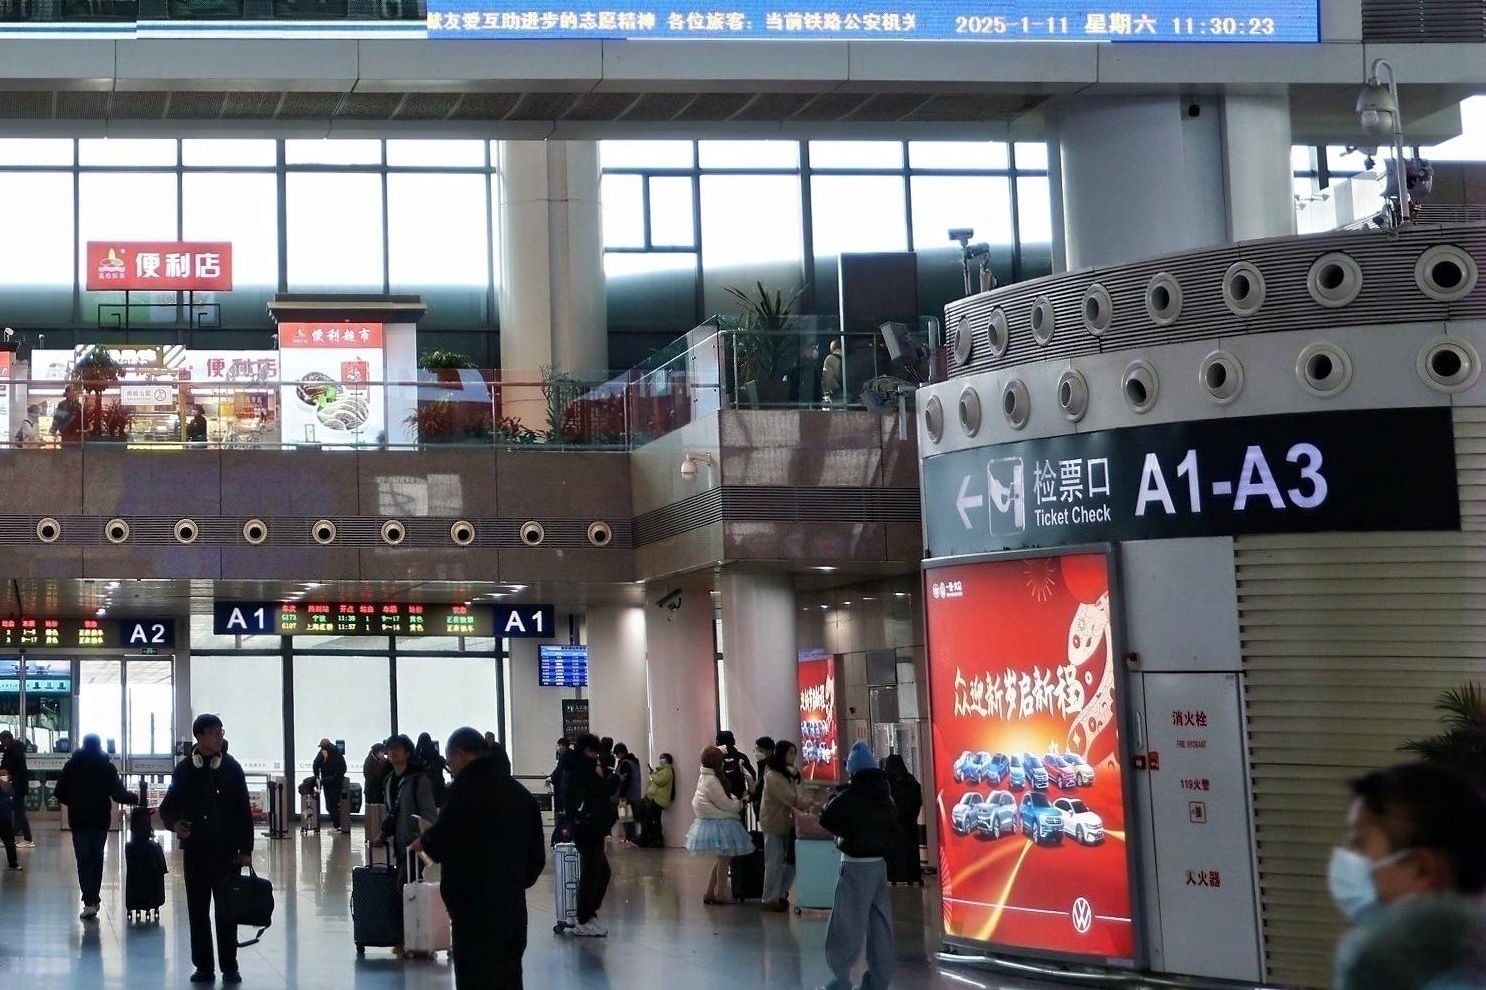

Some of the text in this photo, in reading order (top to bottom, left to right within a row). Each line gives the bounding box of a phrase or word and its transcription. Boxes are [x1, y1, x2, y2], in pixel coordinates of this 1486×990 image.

[955, 13, 1275, 36] 2025-1-11 星期六 11:30:23
[135, 251, 220, 278] 便利店
[310, 327, 371, 343] 便利超市
[206, 357, 277, 378] 便利店
[1033, 457, 1111, 505] 检票口
[1134, 442, 1329, 517] A1-A3
[1034, 505, 1112, 527] Ticket Check
[1172, 711, 1208, 727] 消火栓
